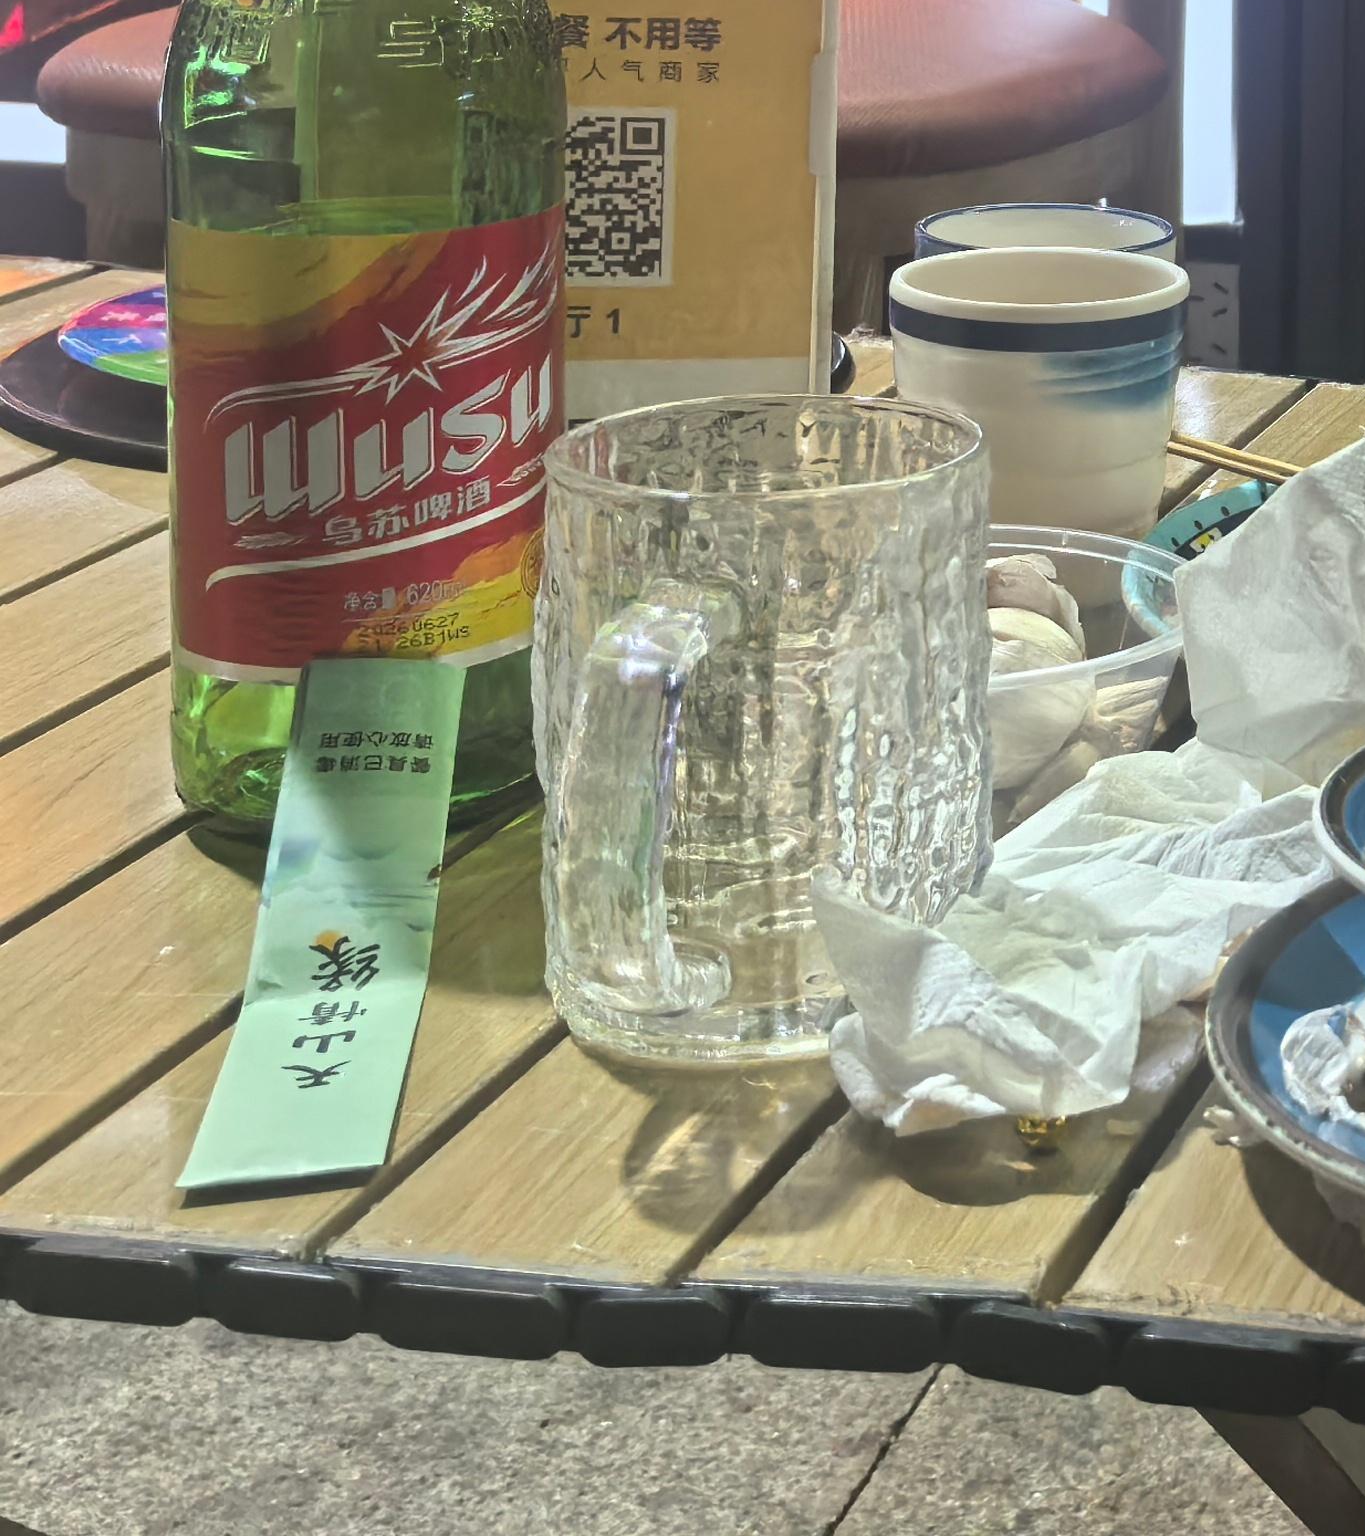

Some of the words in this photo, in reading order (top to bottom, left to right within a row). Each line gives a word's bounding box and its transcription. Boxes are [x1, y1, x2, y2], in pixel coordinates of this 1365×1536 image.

[605, 17, 722, 51] 不用等
[563, 57, 720, 84] 人气商家
[322, 476, 491, 546] 乌苏啤酒
[343, 586, 396, 612] 净含
[319, 731, 434, 750] 请放心使用
[280, 935, 381, 1089] 天山情缘
